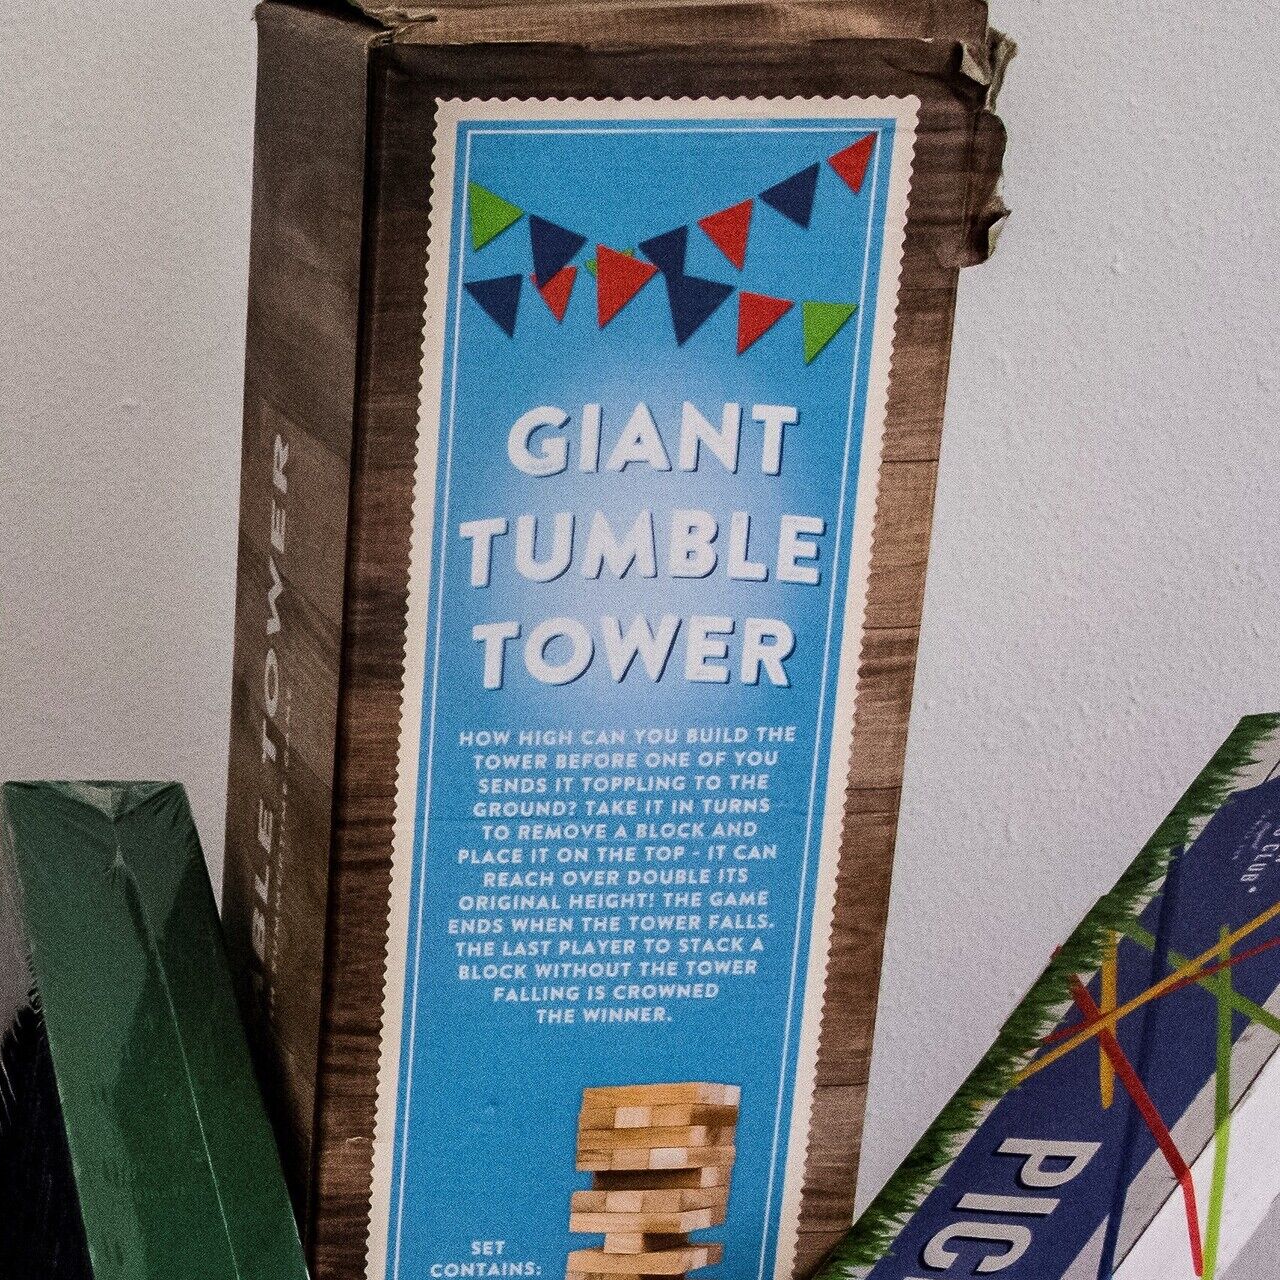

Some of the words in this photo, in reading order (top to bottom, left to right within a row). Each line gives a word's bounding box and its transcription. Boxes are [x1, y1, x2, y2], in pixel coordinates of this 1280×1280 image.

[506, 402, 798, 476] GIANT
[458, 509, 826, 588] TUMBLE
[472, 615, 795, 690] TOWER
[458, 730, 510, 747] HOW
[518, 729, 573, 746] HIGH
[581, 728, 626, 745] CAN
[636, 727, 678, 744] YOU
[686, 726, 748, 743] BUILD
[757, 725, 796, 742] THE
[473, 752, 548, 770] TOWER
[554, 749, 639, 769] BEFORE
[643, 748, 690, 768] ONE
[696, 750, 727, 767] OF
[733, 749, 778, 766] YOU
[478, 776, 547, 794] SENDS
[554, 776, 574, 792] IT
[580, 774, 686, 793] TOPPLING
[693, 773, 722, 791] TO
[728, 772, 769, 789] THE
[472, 799, 577, 817] GROUND?
[585, 798, 638, 816] TAKE
[644, 798, 663, 815] IT
[670, 799, 694, 814] IN
[701, 796, 770, 814] TURNS
[481, 824, 510, 841] TO
[516, 822, 607, 840] REMOVE
[613, 824, 627, 839] A
[635, 821, 704, 839] BLOCK
[711, 820, 757, 837] AND
[457, 847, 523, 864] PLACE
[530, 846, 549, 863] IT
[555, 846, 589, 863] ON
[596, 845, 637, 862] THE
[644, 844, 685, 862] TOP
[707, 843, 726, 860] IT
[732, 843, 777, 861] CAN
[482, 870, 554, 887] REACH
[561, 869, 620, 886] OVER
[626, 867, 710, 886] DOUBLE
[717, 866, 748, 883] ITS
[457, 894, 561, 911] ORIGINAL
[568, 891, 655, 909] HEIGHT!
[662, 891, 702, 908] THE
[708, 889, 768, 907] GAME
[447, 917, 504, 934] ENDS
[510, 916, 573, 933] WHEN
[581, 915, 621, 932] THE
[628, 913, 701, 931] TOWER
[707, 912, 774, 930] FALLS.
[455, 940, 495, 957] THE
[501, 939, 551, 957] LAST
[557, 938, 636, 955] PLAYER
[643, 937, 671, 954] TO
[677, 936, 743, 954] STACK
[750, 936, 764, 951] A
[457, 963, 526, 980] BLOCK
[534, 960, 632, 978] WITHOUT
[638, 960, 678, 977] THE
[685, 958, 757, 976] TOWER
[492, 985, 580, 1002] FALLING
[586, 984, 606, 1001] IS
[611, 982, 719, 1000] CROWNED
[536, 1007, 575, 1024] THE
[582, 1005, 672, 1023] WINNER.
[470, 1239, 505, 1256] SET
[429, 1260, 541, 1278] CONTAINS:
